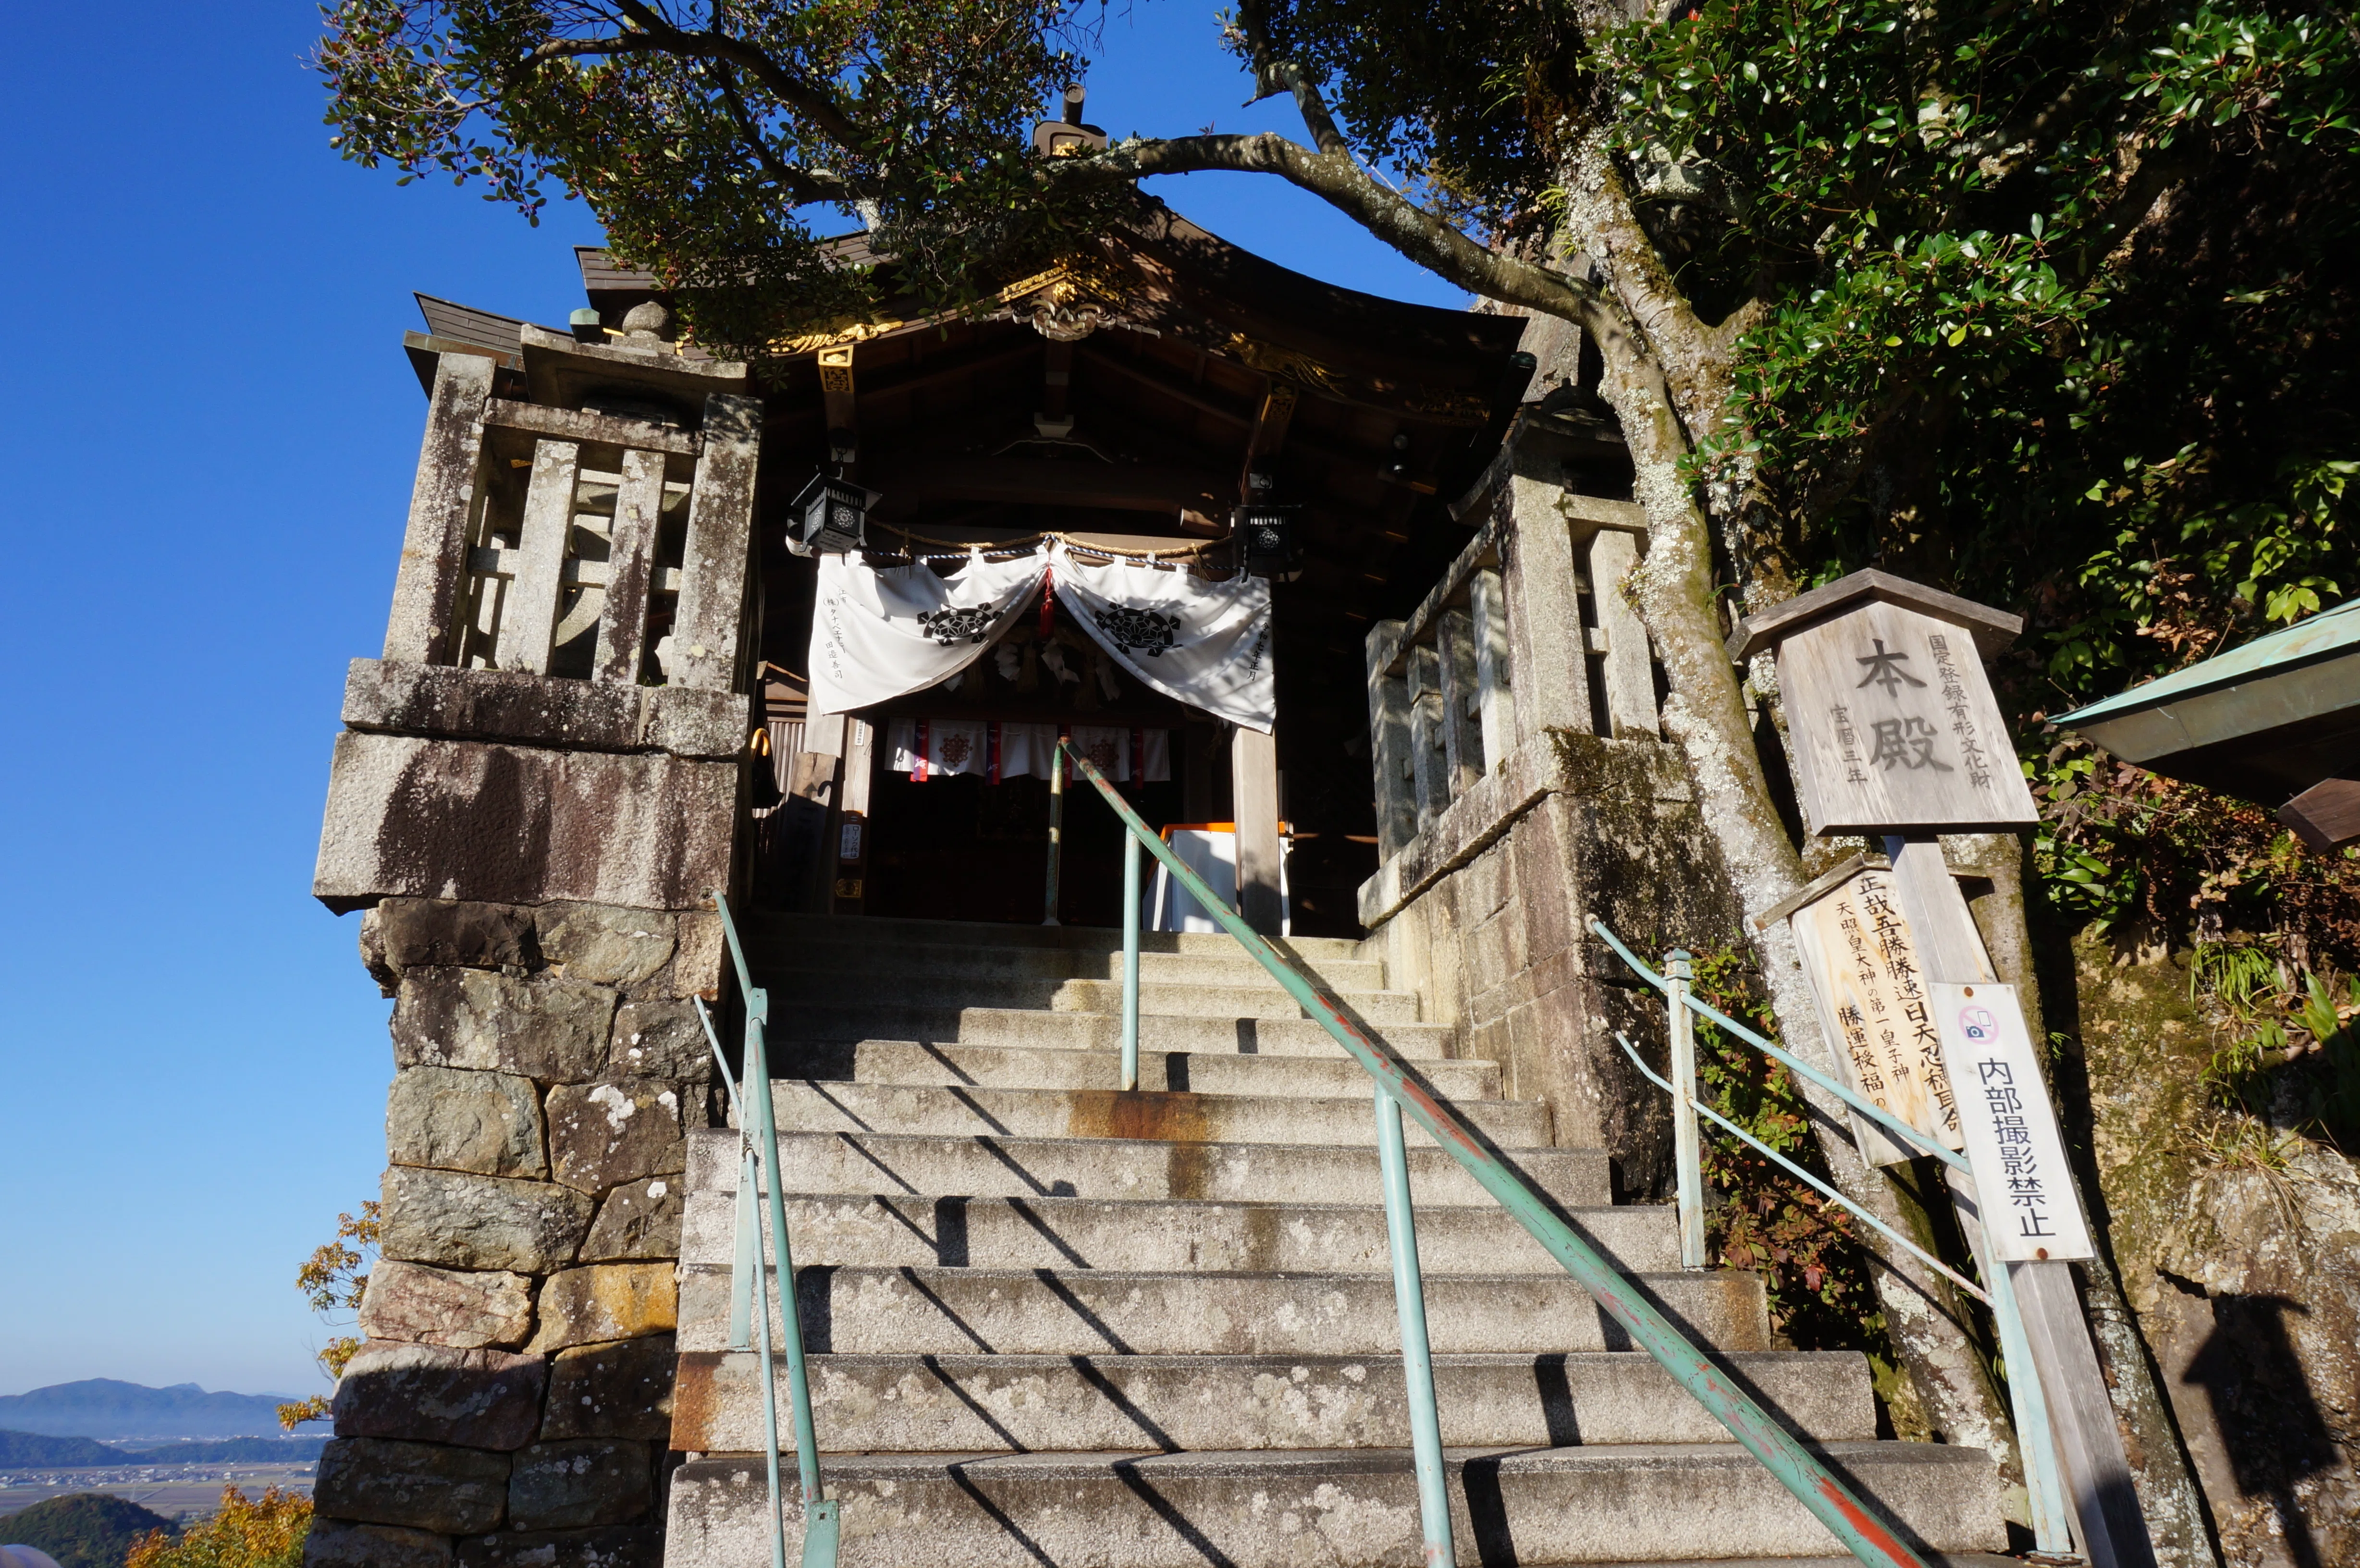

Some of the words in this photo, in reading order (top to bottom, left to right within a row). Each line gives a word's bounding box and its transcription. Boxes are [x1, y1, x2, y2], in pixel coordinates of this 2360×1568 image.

[1247, 622, 1270, 681] 令和七年正月
[1856, 638, 1954, 772] 本殿
[1929, 635, 1991, 789] 国定登録有形文化財
[1830, 704, 1868, 785] 宝暦三年
[1836, 902, 1909, 1082] 天照皇大神の第一皇子神
[1838, 1004, 1886, 1134] 勝運授福の
[1978, 1057, 2056, 1237] 内部撮影禁止
